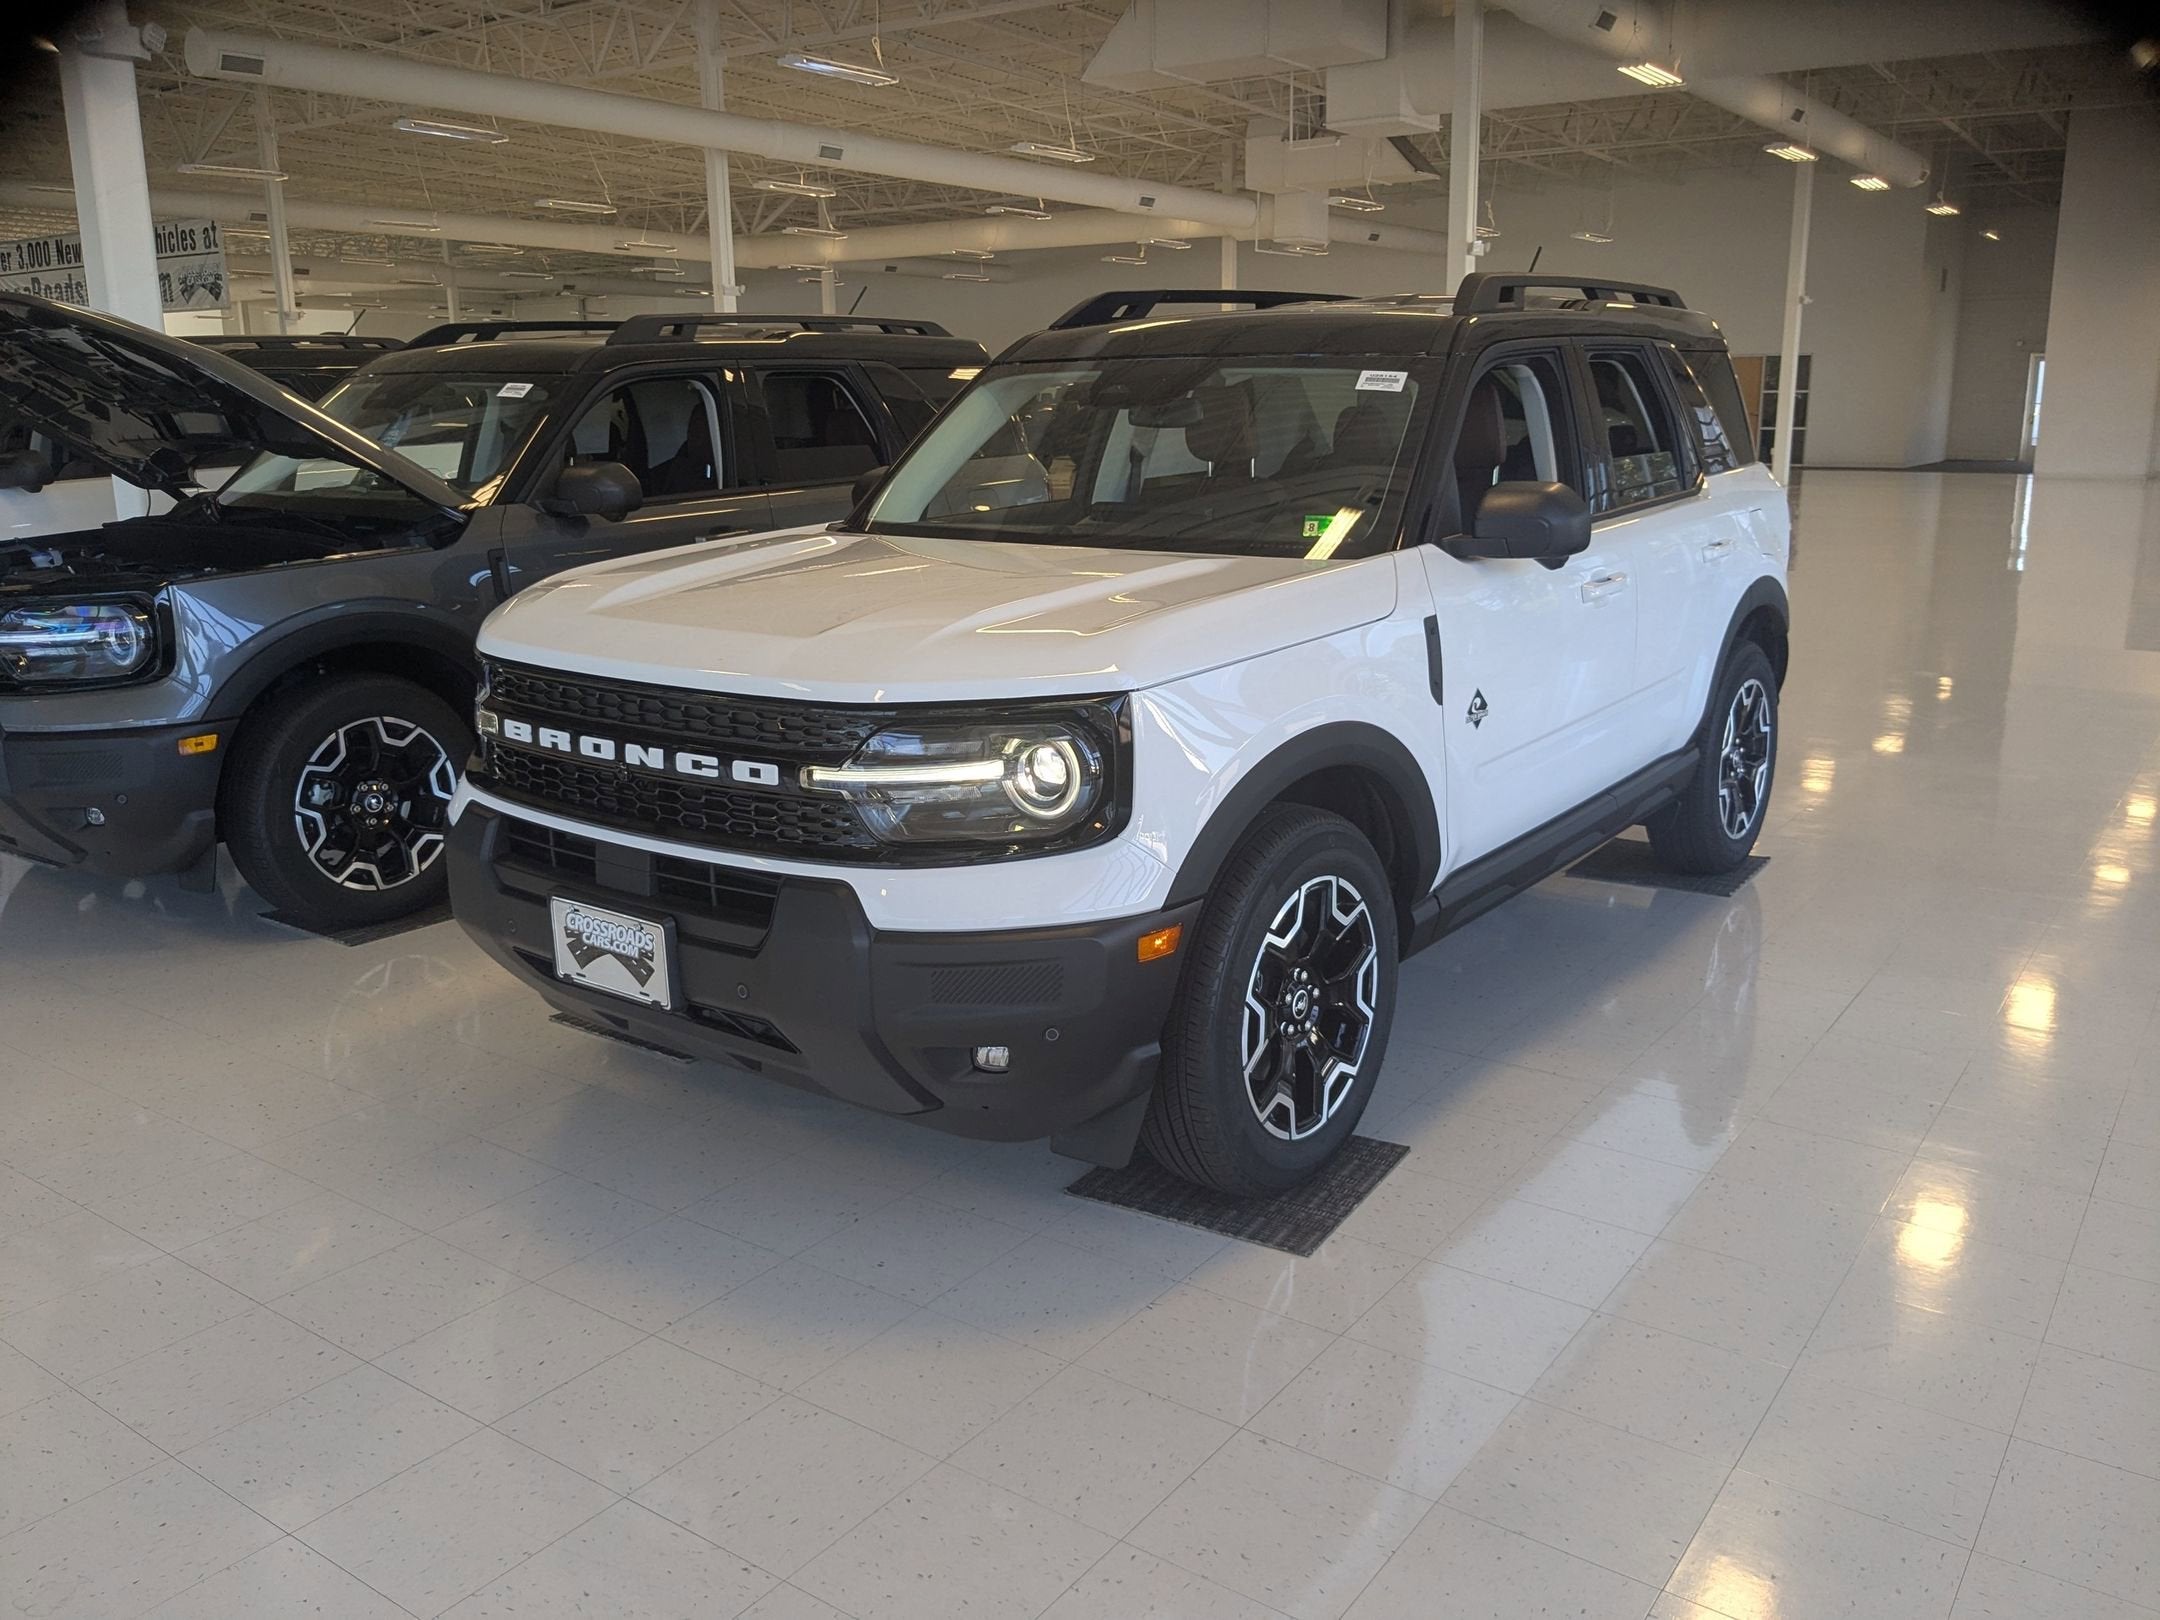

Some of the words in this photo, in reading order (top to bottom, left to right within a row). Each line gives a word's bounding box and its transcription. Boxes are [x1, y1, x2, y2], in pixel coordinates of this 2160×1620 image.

[16, 240, 51, 271] 3,000
[55, 238, 82, 265] New
[202, 220, 219, 250] at
[1308, 522, 1316, 532] 8
[503, 718, 780, 787] BRONCO
[565, 912, 656, 952] CROSSROADS
[581, 931, 641, 960] CARS.COM
